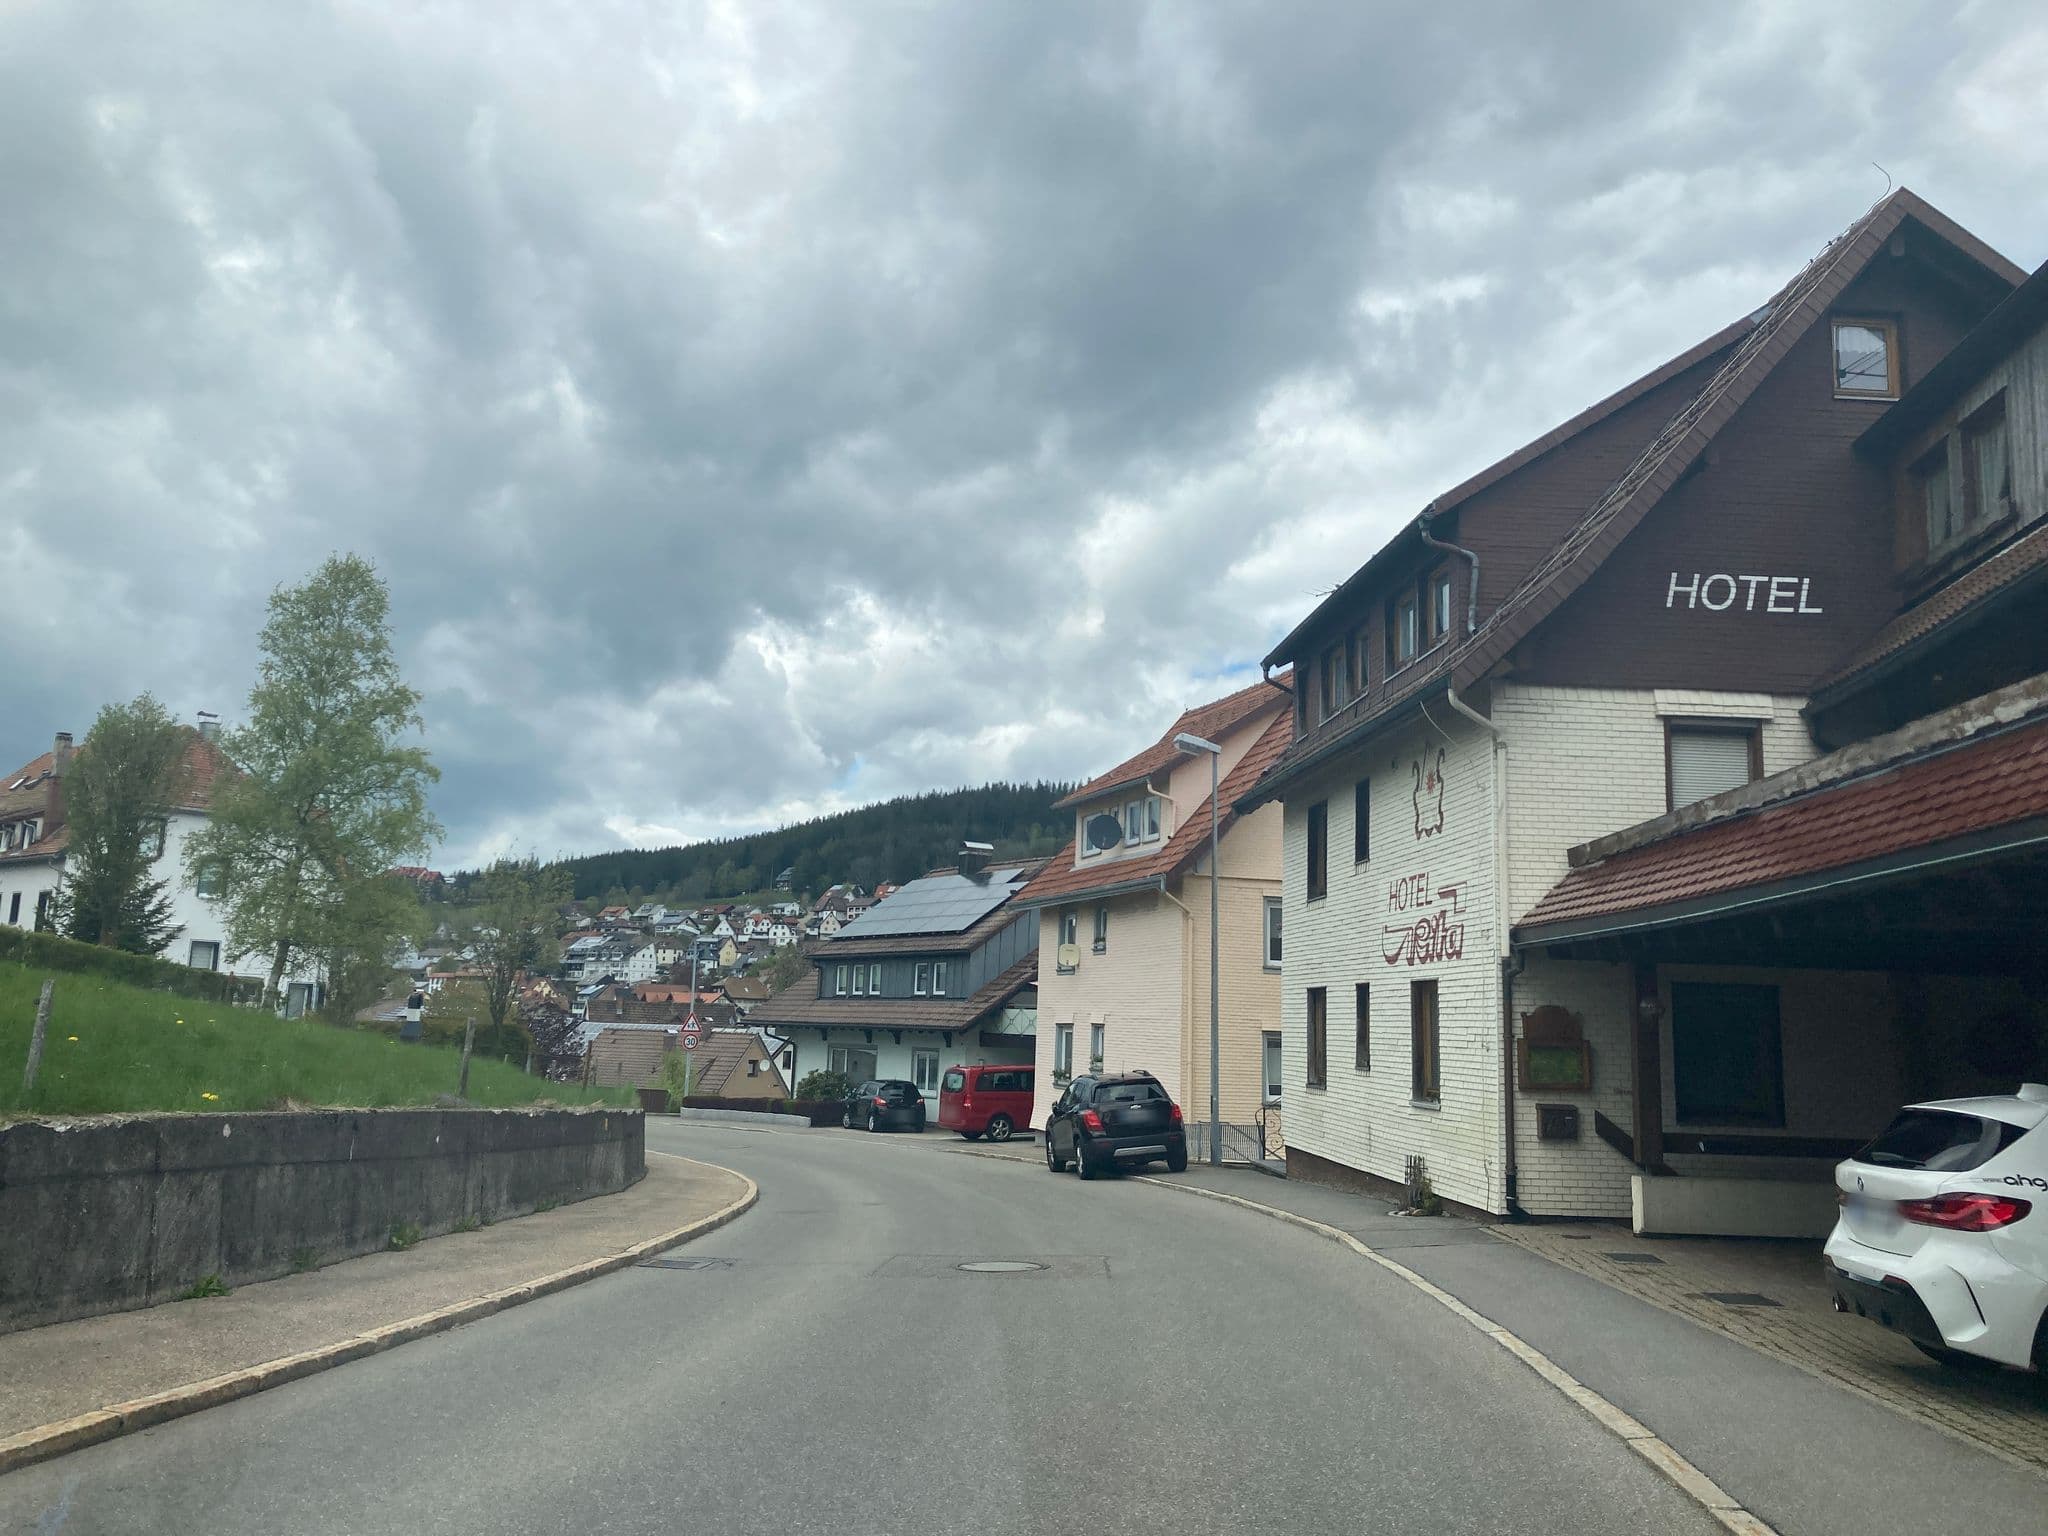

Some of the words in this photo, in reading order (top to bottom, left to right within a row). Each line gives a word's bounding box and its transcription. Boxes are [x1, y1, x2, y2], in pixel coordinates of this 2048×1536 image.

[1666, 572, 1823, 613] HOTEL
[1389, 872, 1433, 912] HOTEL
[686, 1037, 696, 1046] 30
